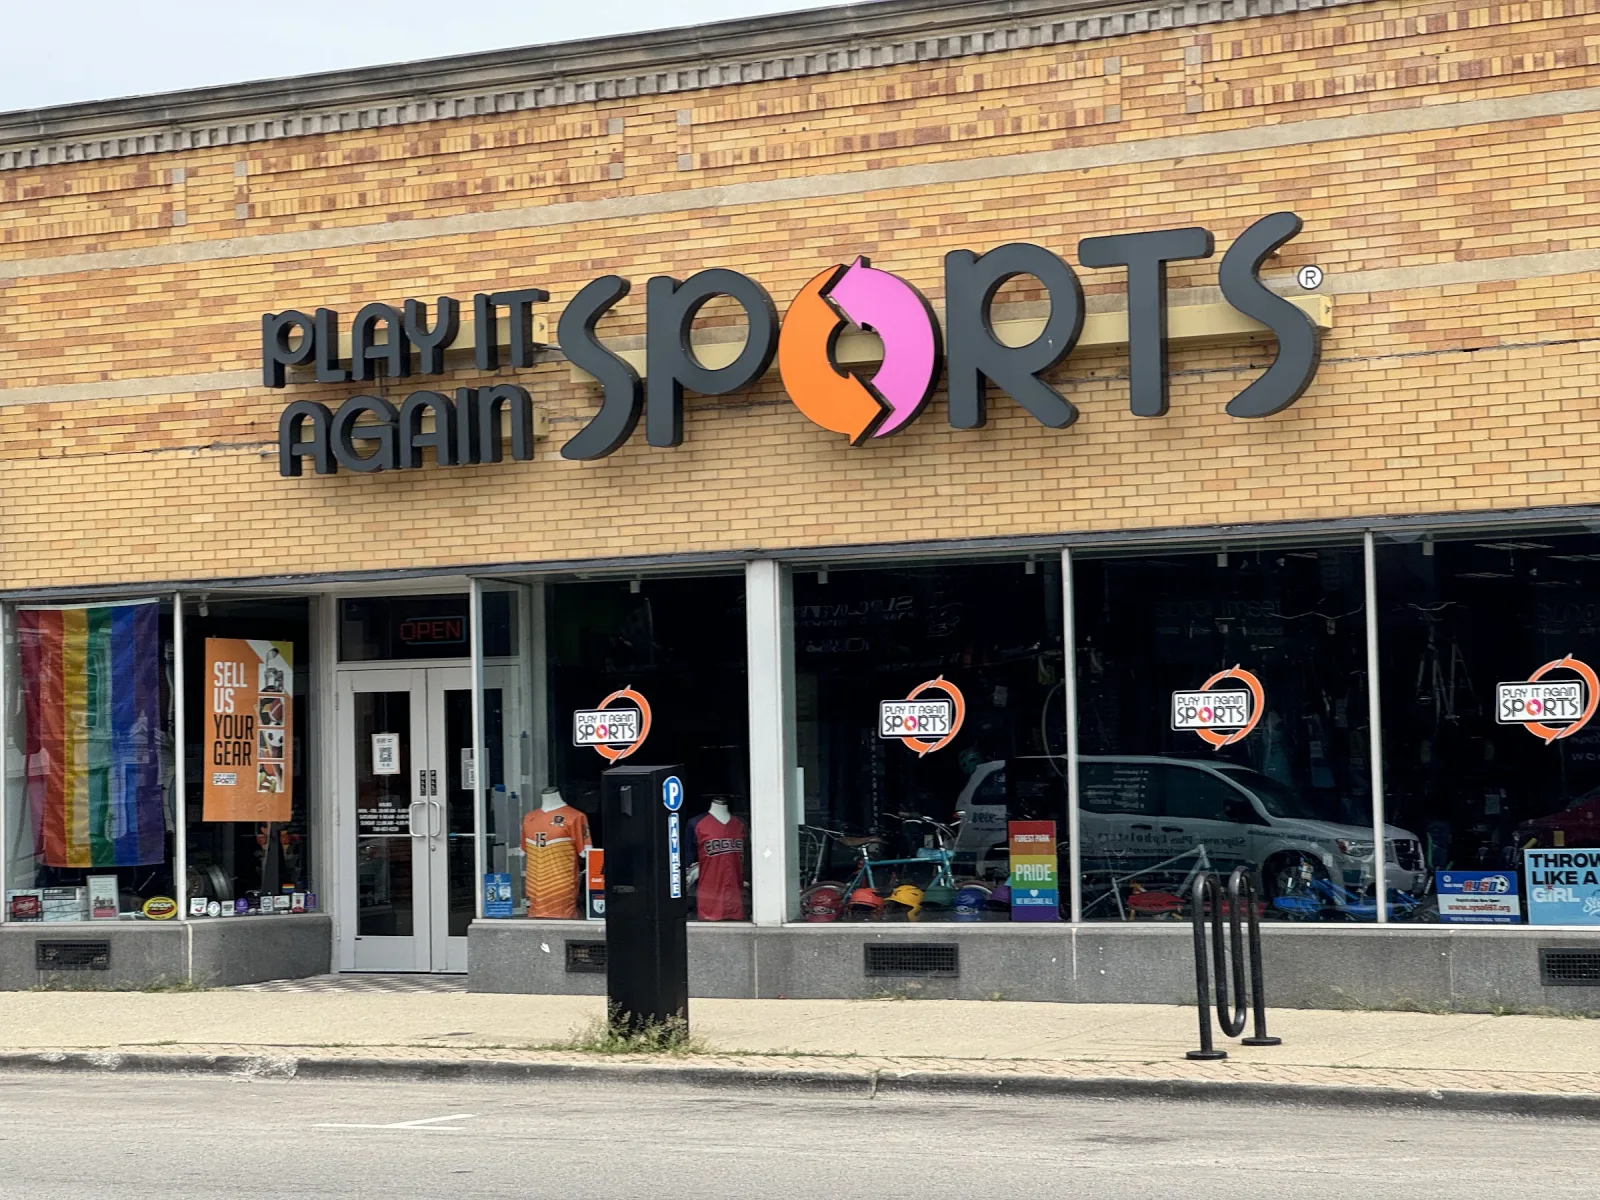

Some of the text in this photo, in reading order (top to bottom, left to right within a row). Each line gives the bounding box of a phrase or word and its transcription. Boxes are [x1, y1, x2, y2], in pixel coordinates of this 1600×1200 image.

[262, 288, 549, 389] PLAY IT
[556, 211, 1322, 461] SPORTS
[279, 384, 534, 477] AGAIN
[400, 621, 461, 640] OPEN
[213, 661, 248, 688] SELL
[213, 687, 234, 713] US
[1177, 695, 1244, 706] PLAY IT AGAIN
[1502, 686, 1577, 698] PLAY IT AGAIN
[884, 705, 946, 715] PLAY IT AGAIN
[1177, 705, 1245, 724] SPORTS
[1502, 697, 1578, 717] SPORTS
[213, 714, 254, 740] YOUR
[577, 713, 634, 724] PLAY IT AGAIN
[884, 714, 947, 732] SPORTS
[578, 722, 635, 740] SPORTS
[213, 741, 252, 766] GEAR
[668, 782, 679, 806] P
[535, 832, 547, 848] 15
[671, 816, 680, 849] PAY
[1015, 864, 1052, 881] PRIDE
[1532, 870, 1599, 885] LIKE A
